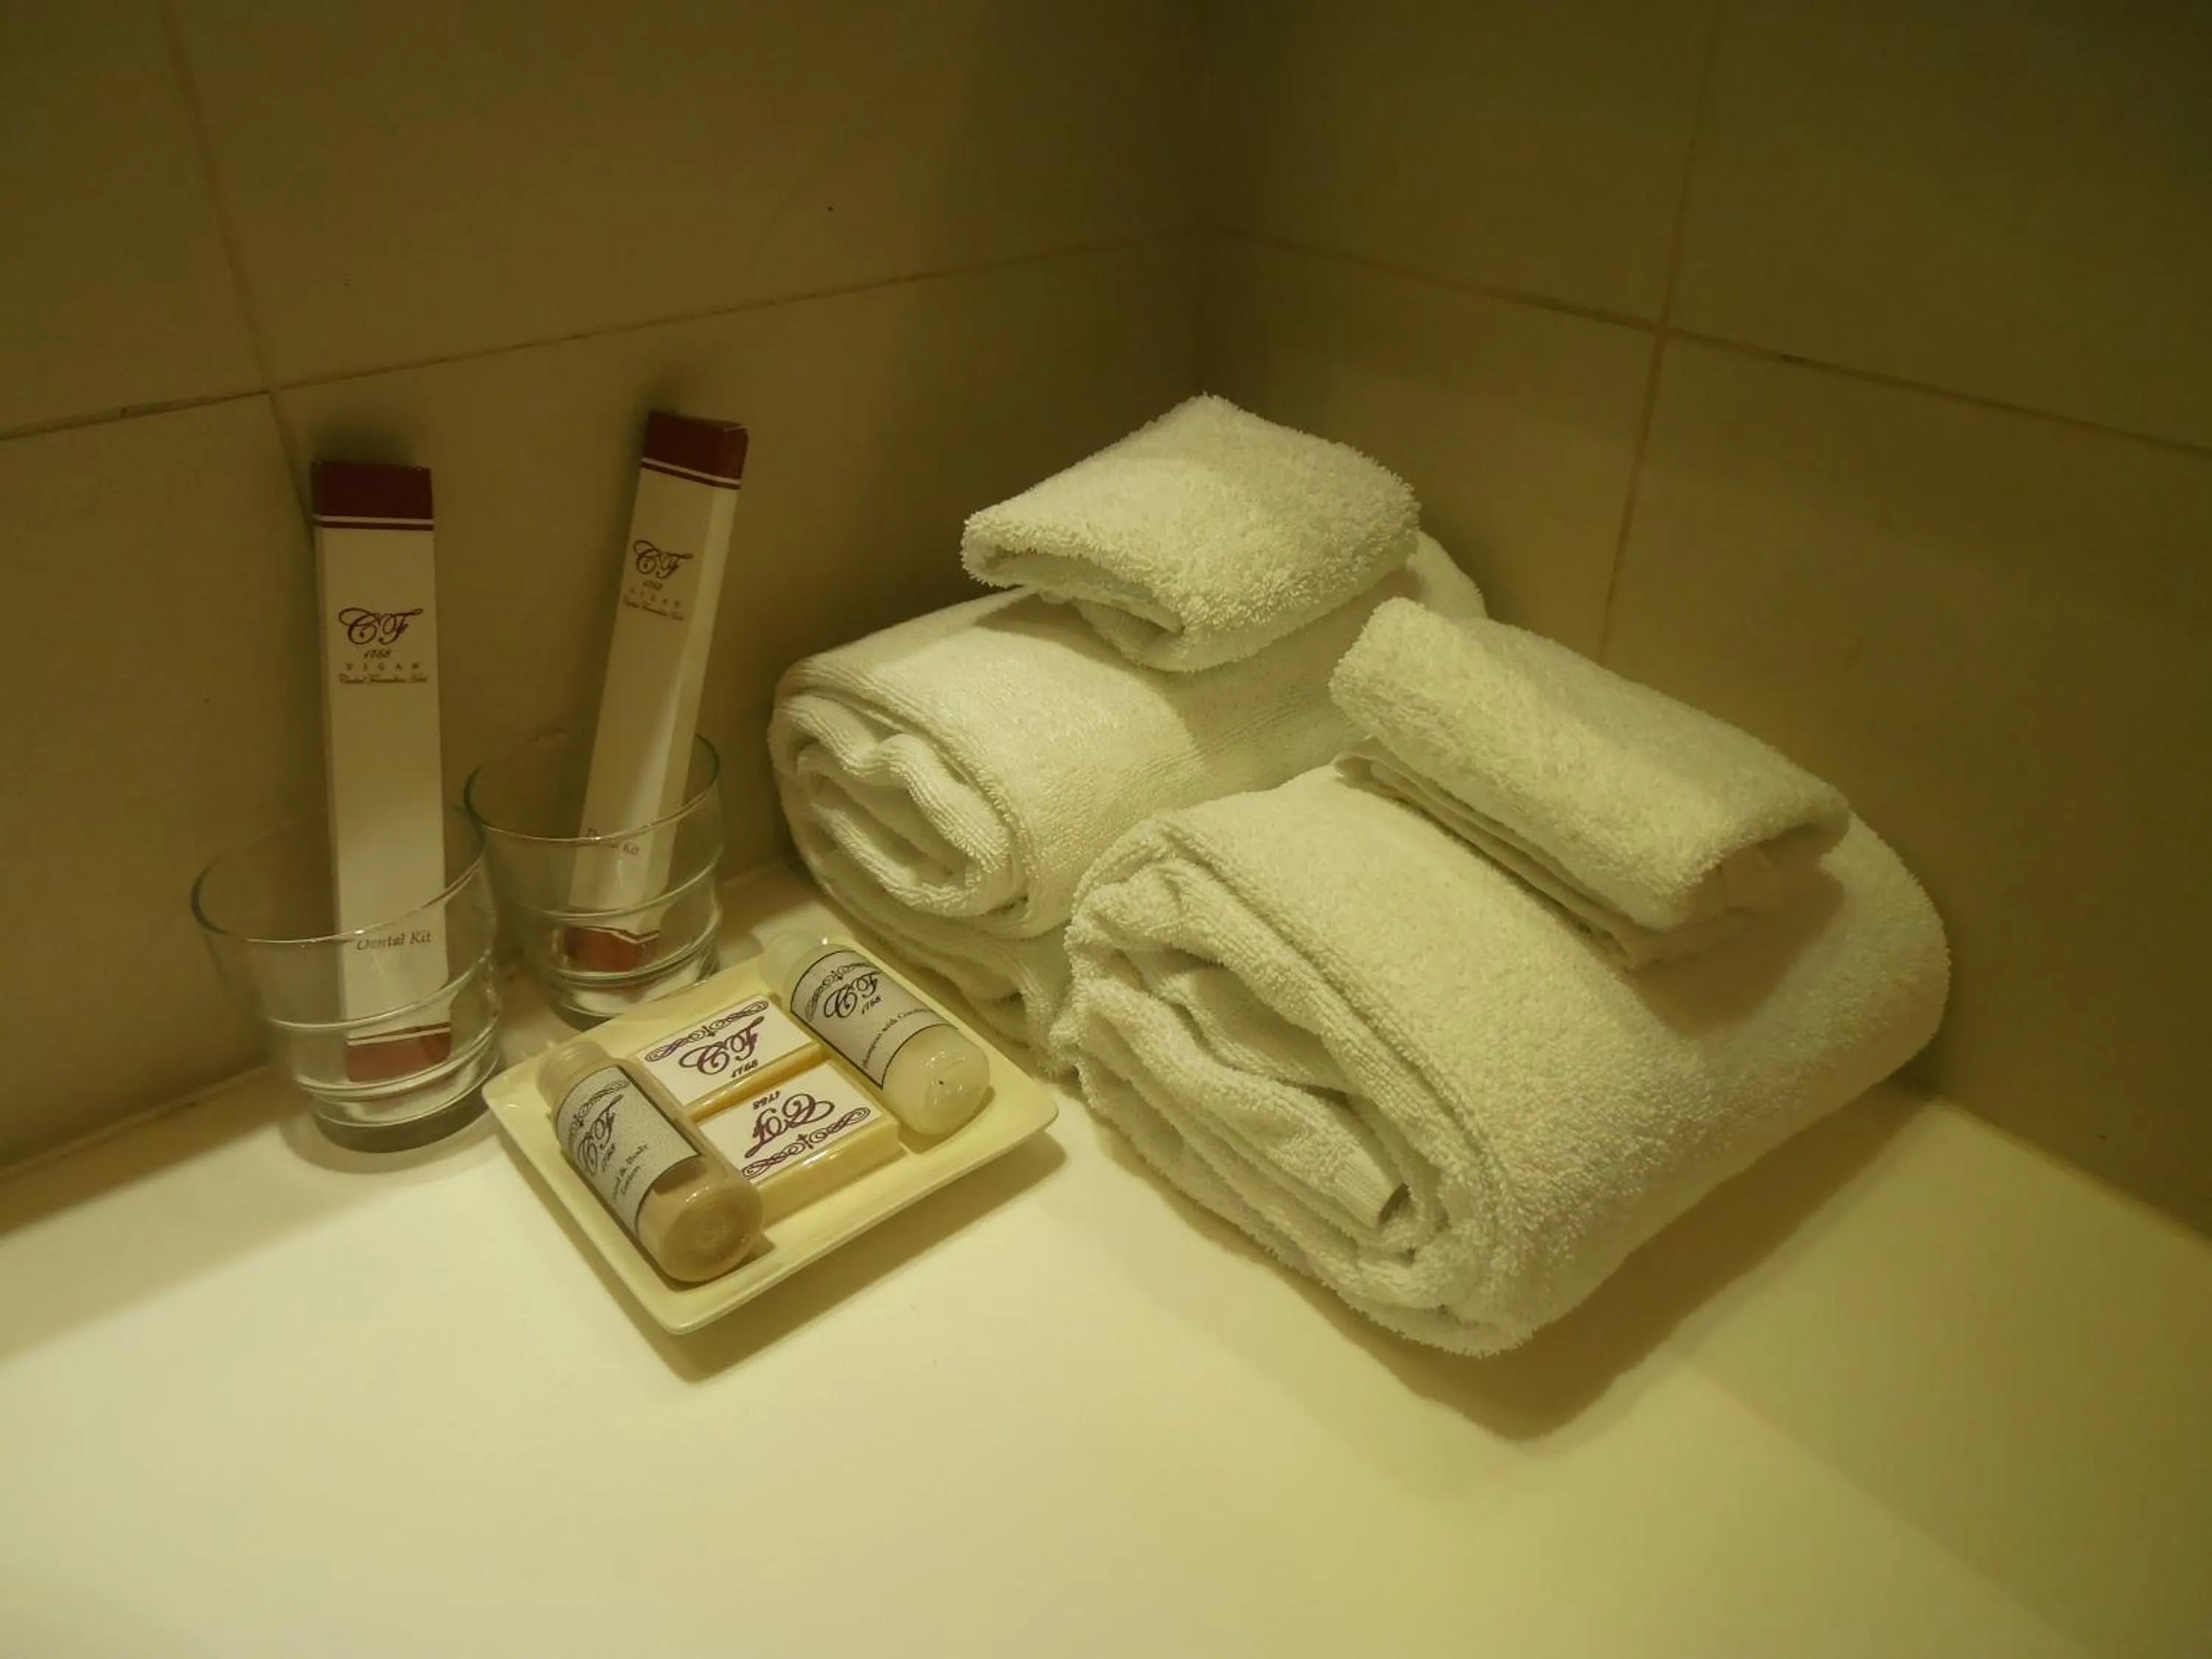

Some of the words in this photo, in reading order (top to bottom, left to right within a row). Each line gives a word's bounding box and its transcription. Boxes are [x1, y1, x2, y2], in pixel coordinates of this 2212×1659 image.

[338, 607, 424, 646] CF
[678, 1016, 765, 1075] CF
[743, 1093, 835, 1159] CF
